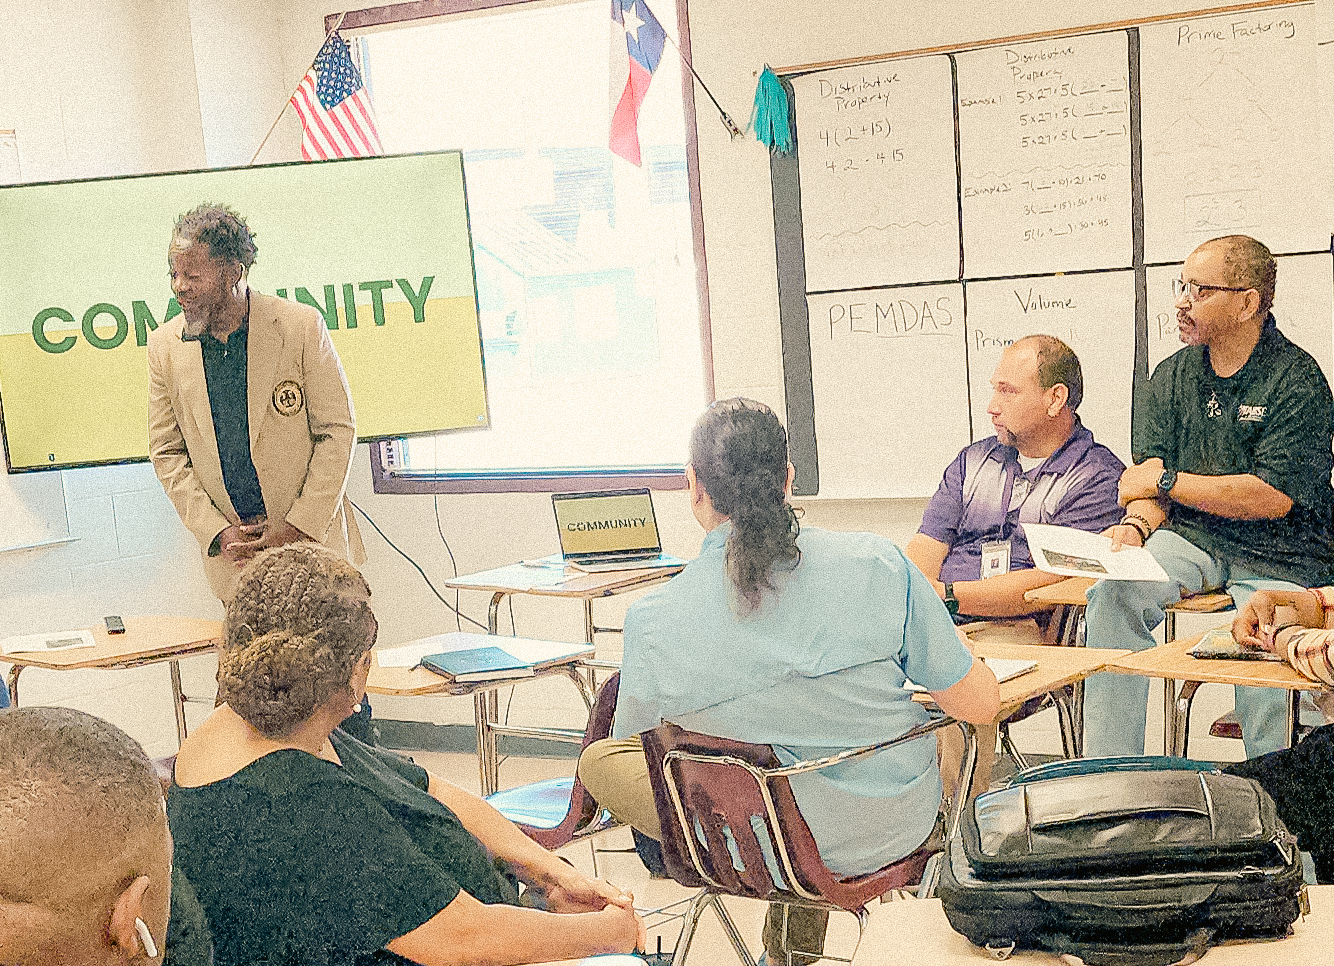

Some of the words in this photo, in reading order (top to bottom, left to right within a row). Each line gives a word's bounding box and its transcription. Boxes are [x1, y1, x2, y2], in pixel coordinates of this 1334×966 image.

[1178, 25, 1225, 46] Prime
[819, 73, 900, 98] Distributive
[835, 91, 890, 111] Property
[1014, 288, 1076, 314] Volume
[32, 276, 435, 354] COMNITY
[829, 296, 953, 340] PEMDAS
[567, 517, 646, 532] COMMUNITY
